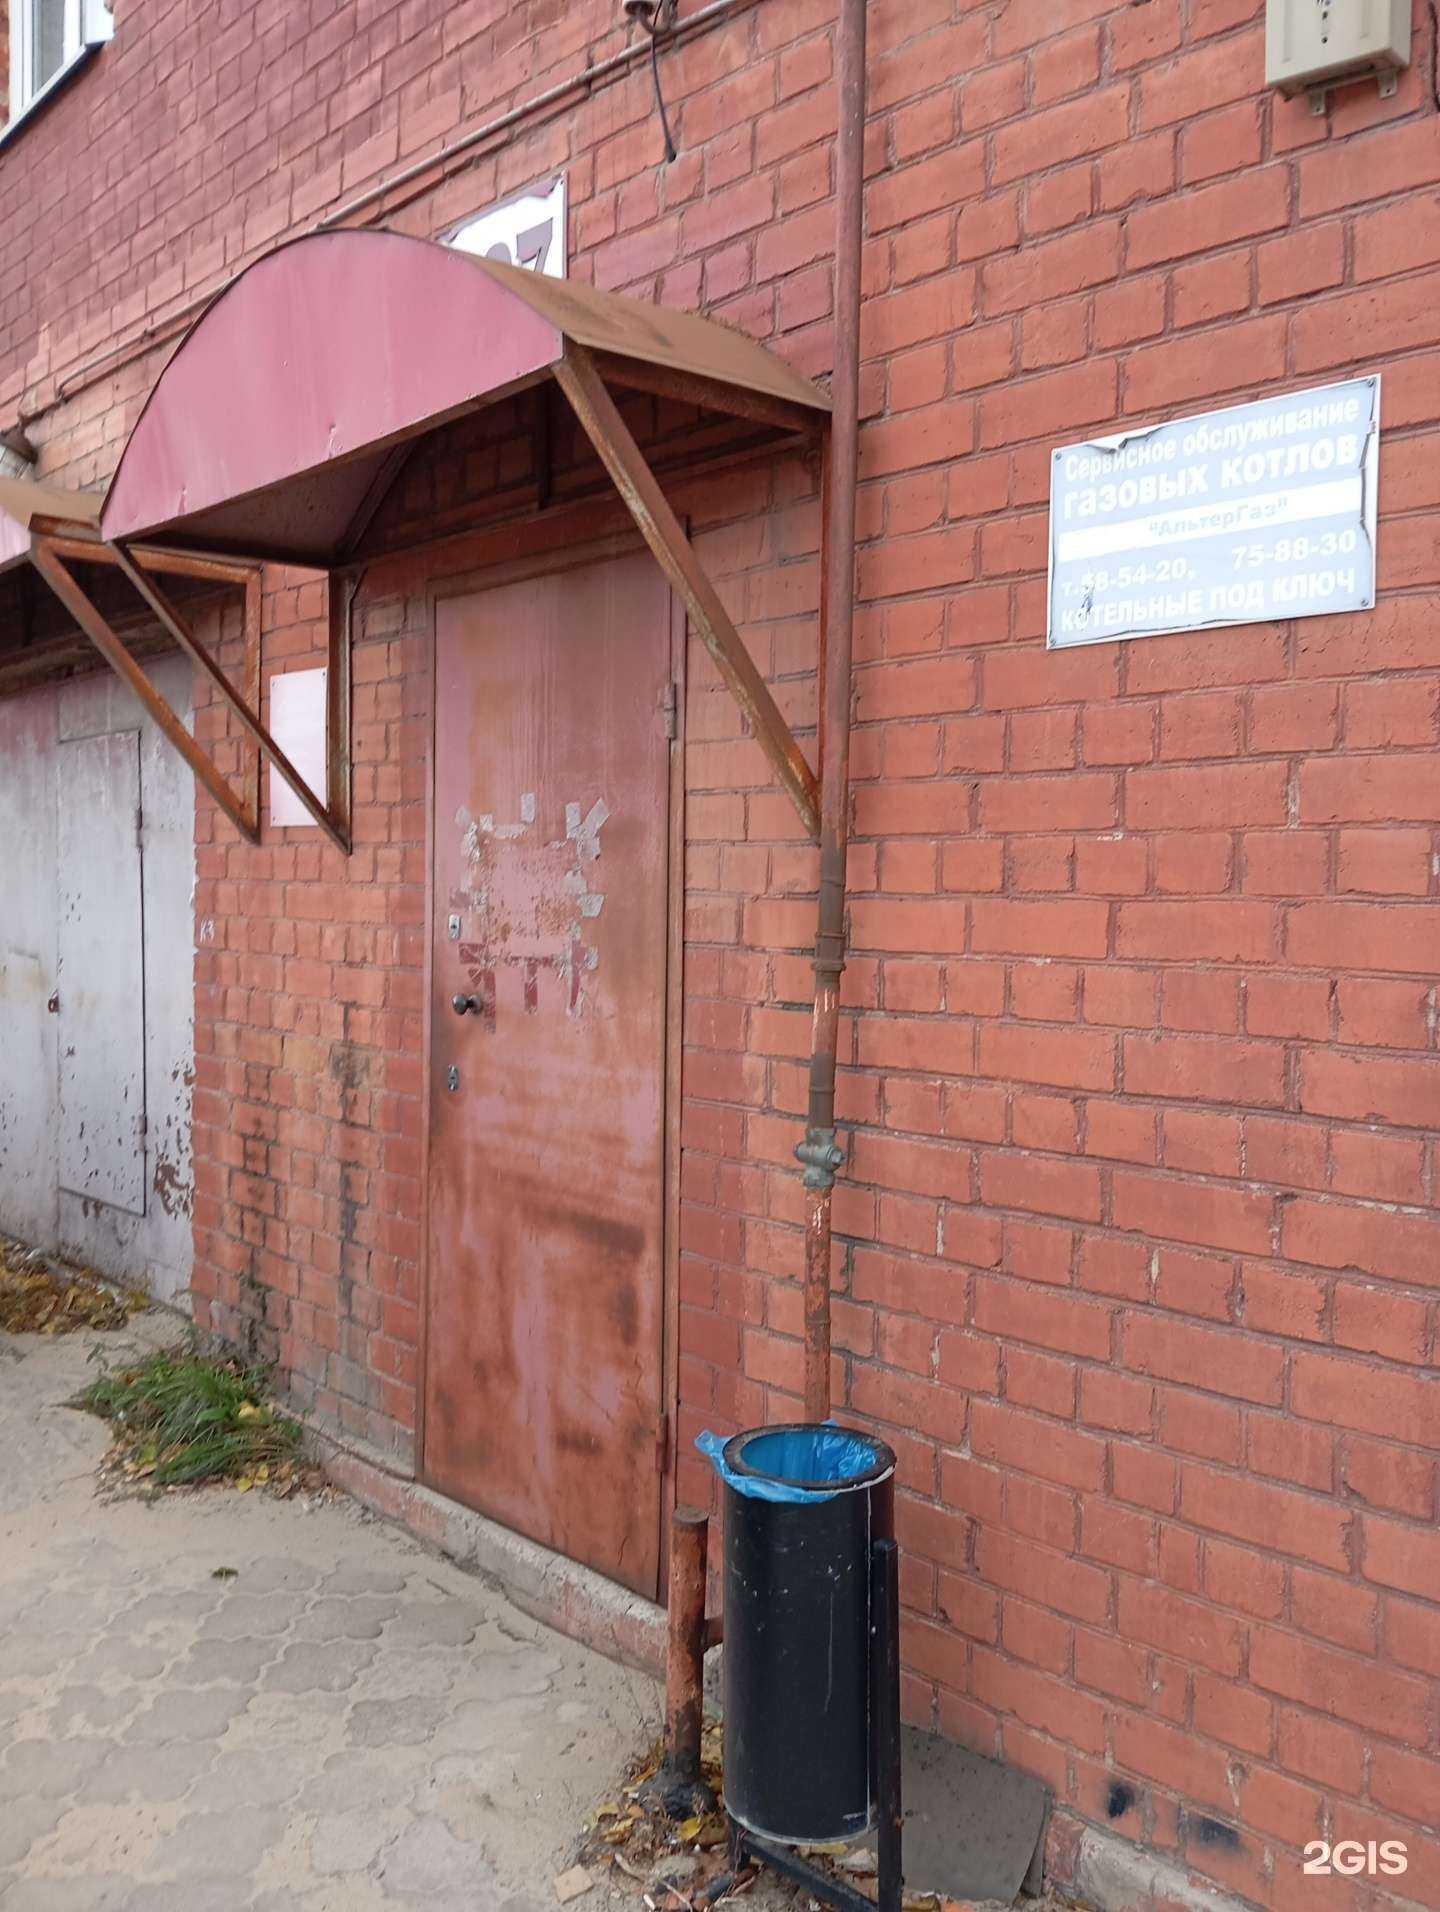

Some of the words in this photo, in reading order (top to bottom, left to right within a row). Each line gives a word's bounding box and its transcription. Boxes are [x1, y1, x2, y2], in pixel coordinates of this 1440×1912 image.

[486, 217, 553, 273] 7
[1064, 438, 1177, 483] Сервисное
[1183, 398, 1360, 453] обслуживание
[1231, 529, 1357, 570] 75-88-30
[1061, 589, 1204, 631] КОТЕЛЬНЫЕ
[1210, 580, 1265, 610] ПОД
[1272, 567, 1356, 602] КЛЮЧ
